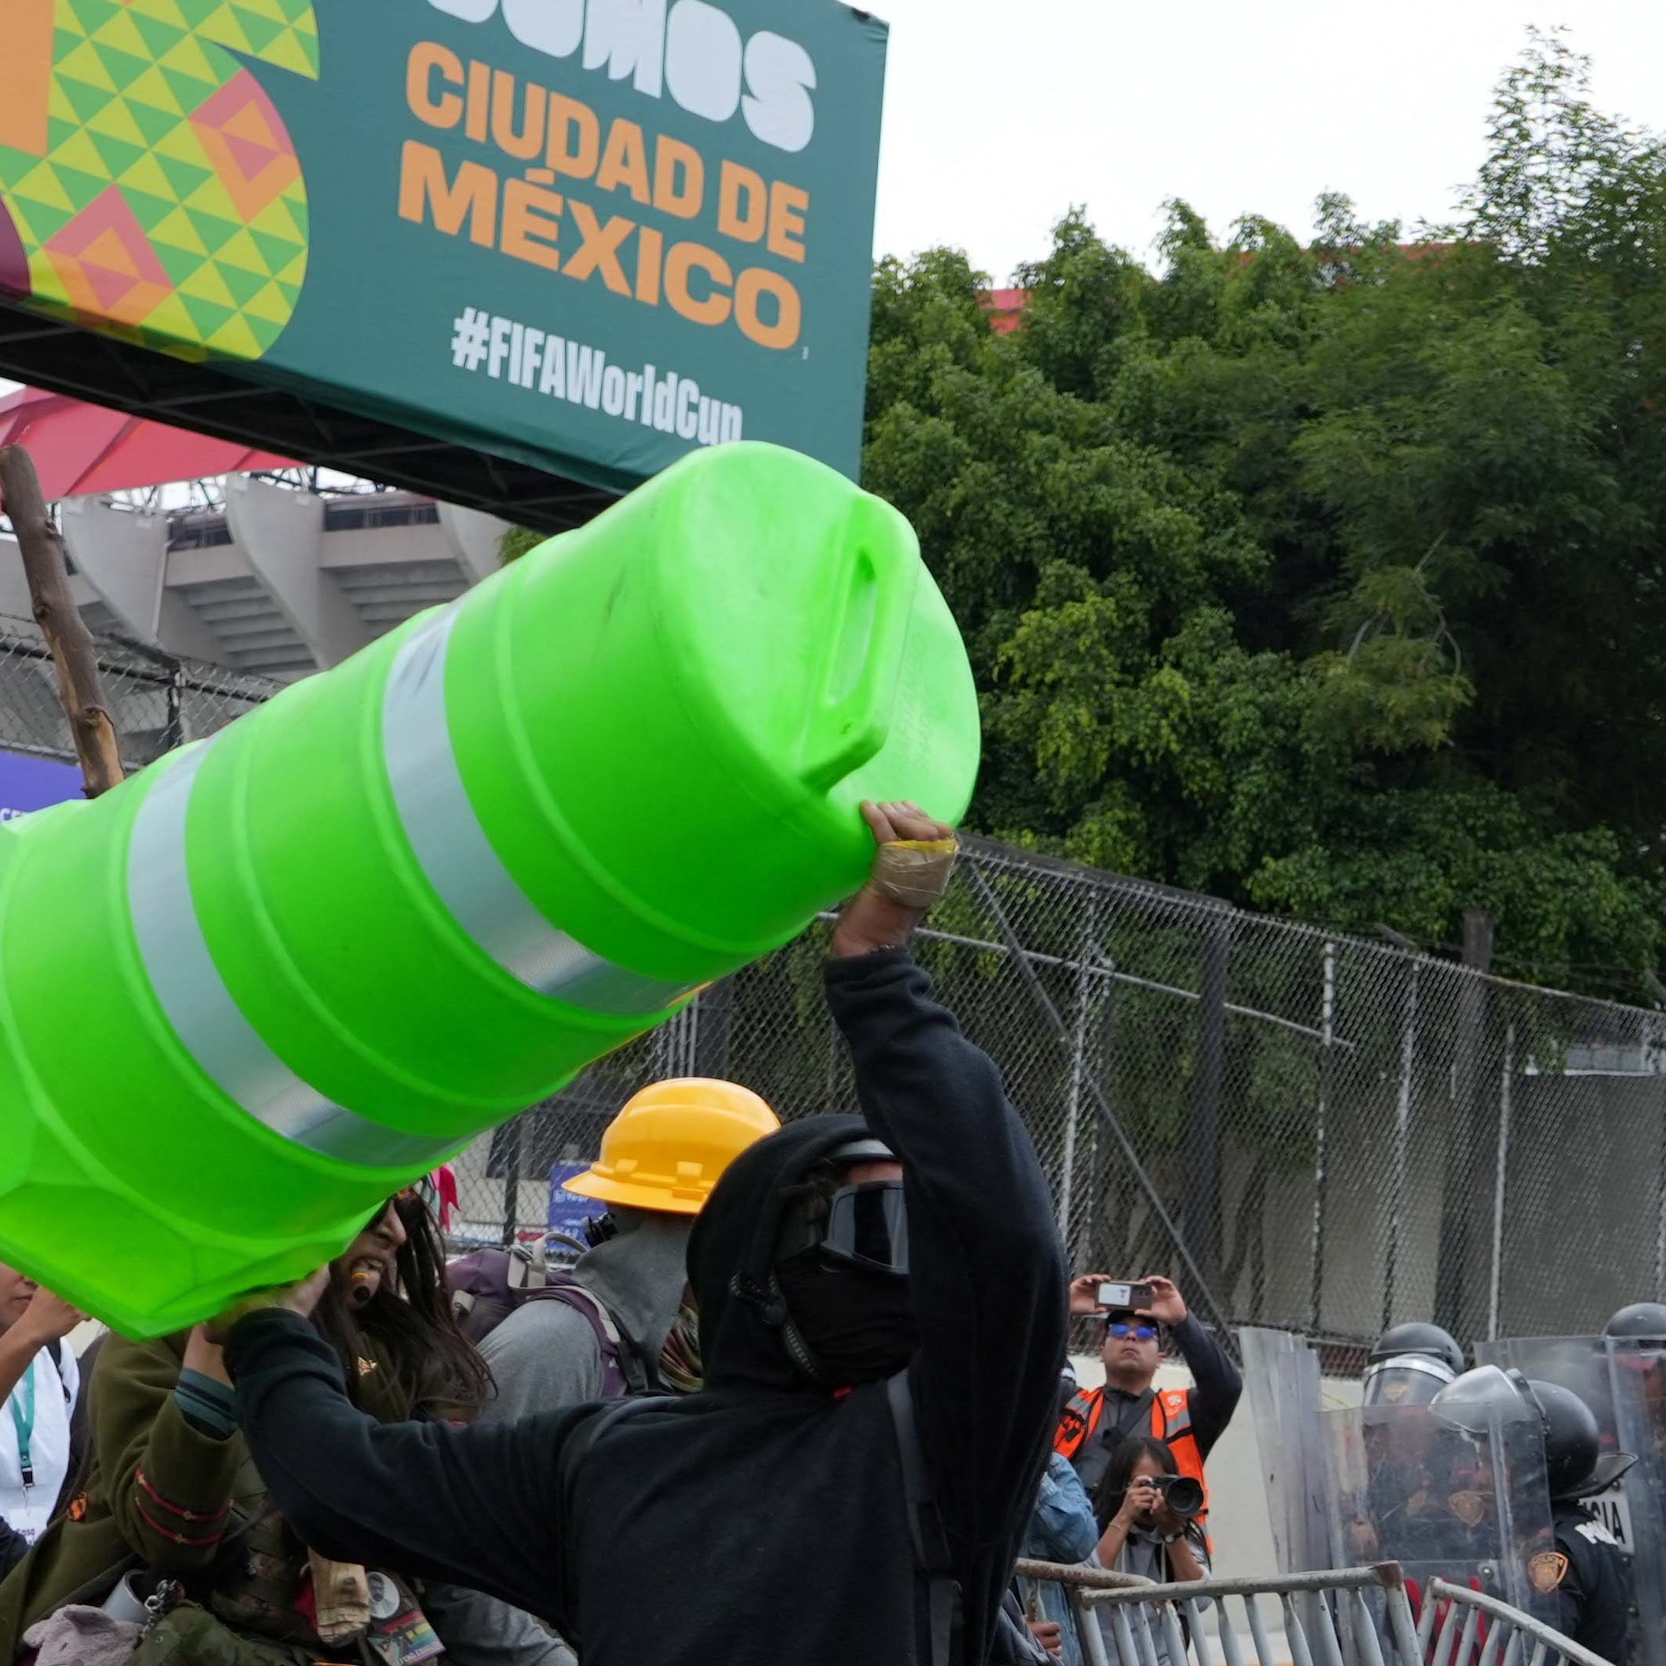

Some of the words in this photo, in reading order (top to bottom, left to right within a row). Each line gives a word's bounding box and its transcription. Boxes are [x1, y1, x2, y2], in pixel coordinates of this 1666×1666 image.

[405, 41, 705, 220] CIUDAD
[717, 159, 810, 263] DE
[427, 0, 818, 153] MOS
[398, 139, 802, 350] MÉXICO
[451, 306, 743, 445] #FIFAWorldCup
